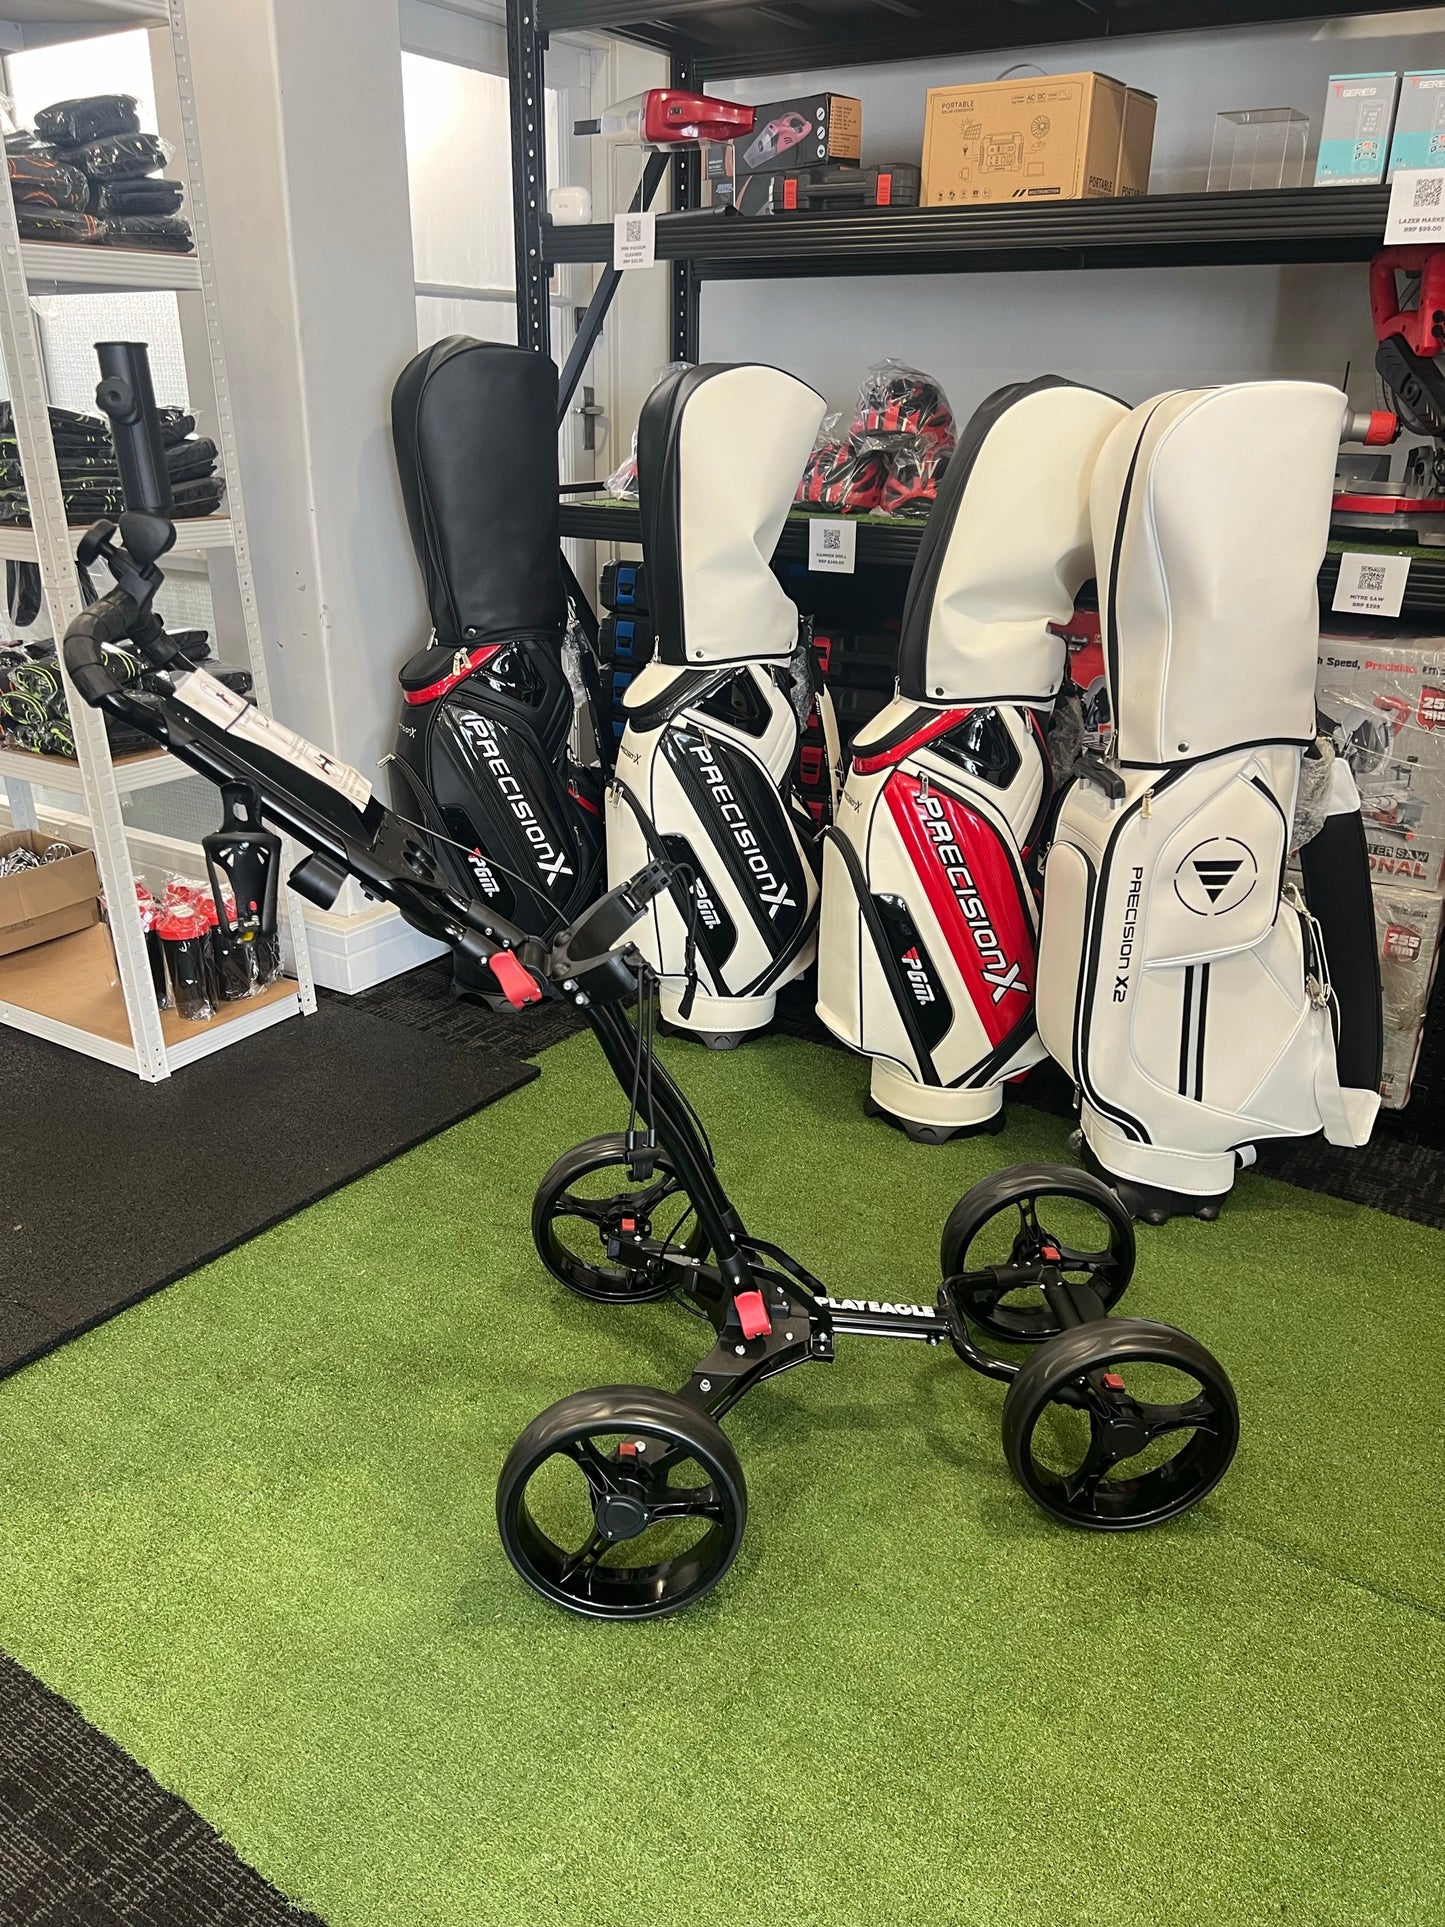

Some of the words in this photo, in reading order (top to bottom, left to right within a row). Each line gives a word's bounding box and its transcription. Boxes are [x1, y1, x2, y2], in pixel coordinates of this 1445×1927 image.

[1343, 88, 1377, 98] SERIES
[942, 100, 974, 110] PORTABLE
[1088, 175, 1113, 193] PORTABLE
[1327, 657, 1361, 670] Speed,
[1118, 866, 1143, 969] PRECISION
[1388, 933, 1420, 947] 255
[1113, 975, 1130, 1003] X2
[813, 1296, 936, 1318] PLAYEAGLE
